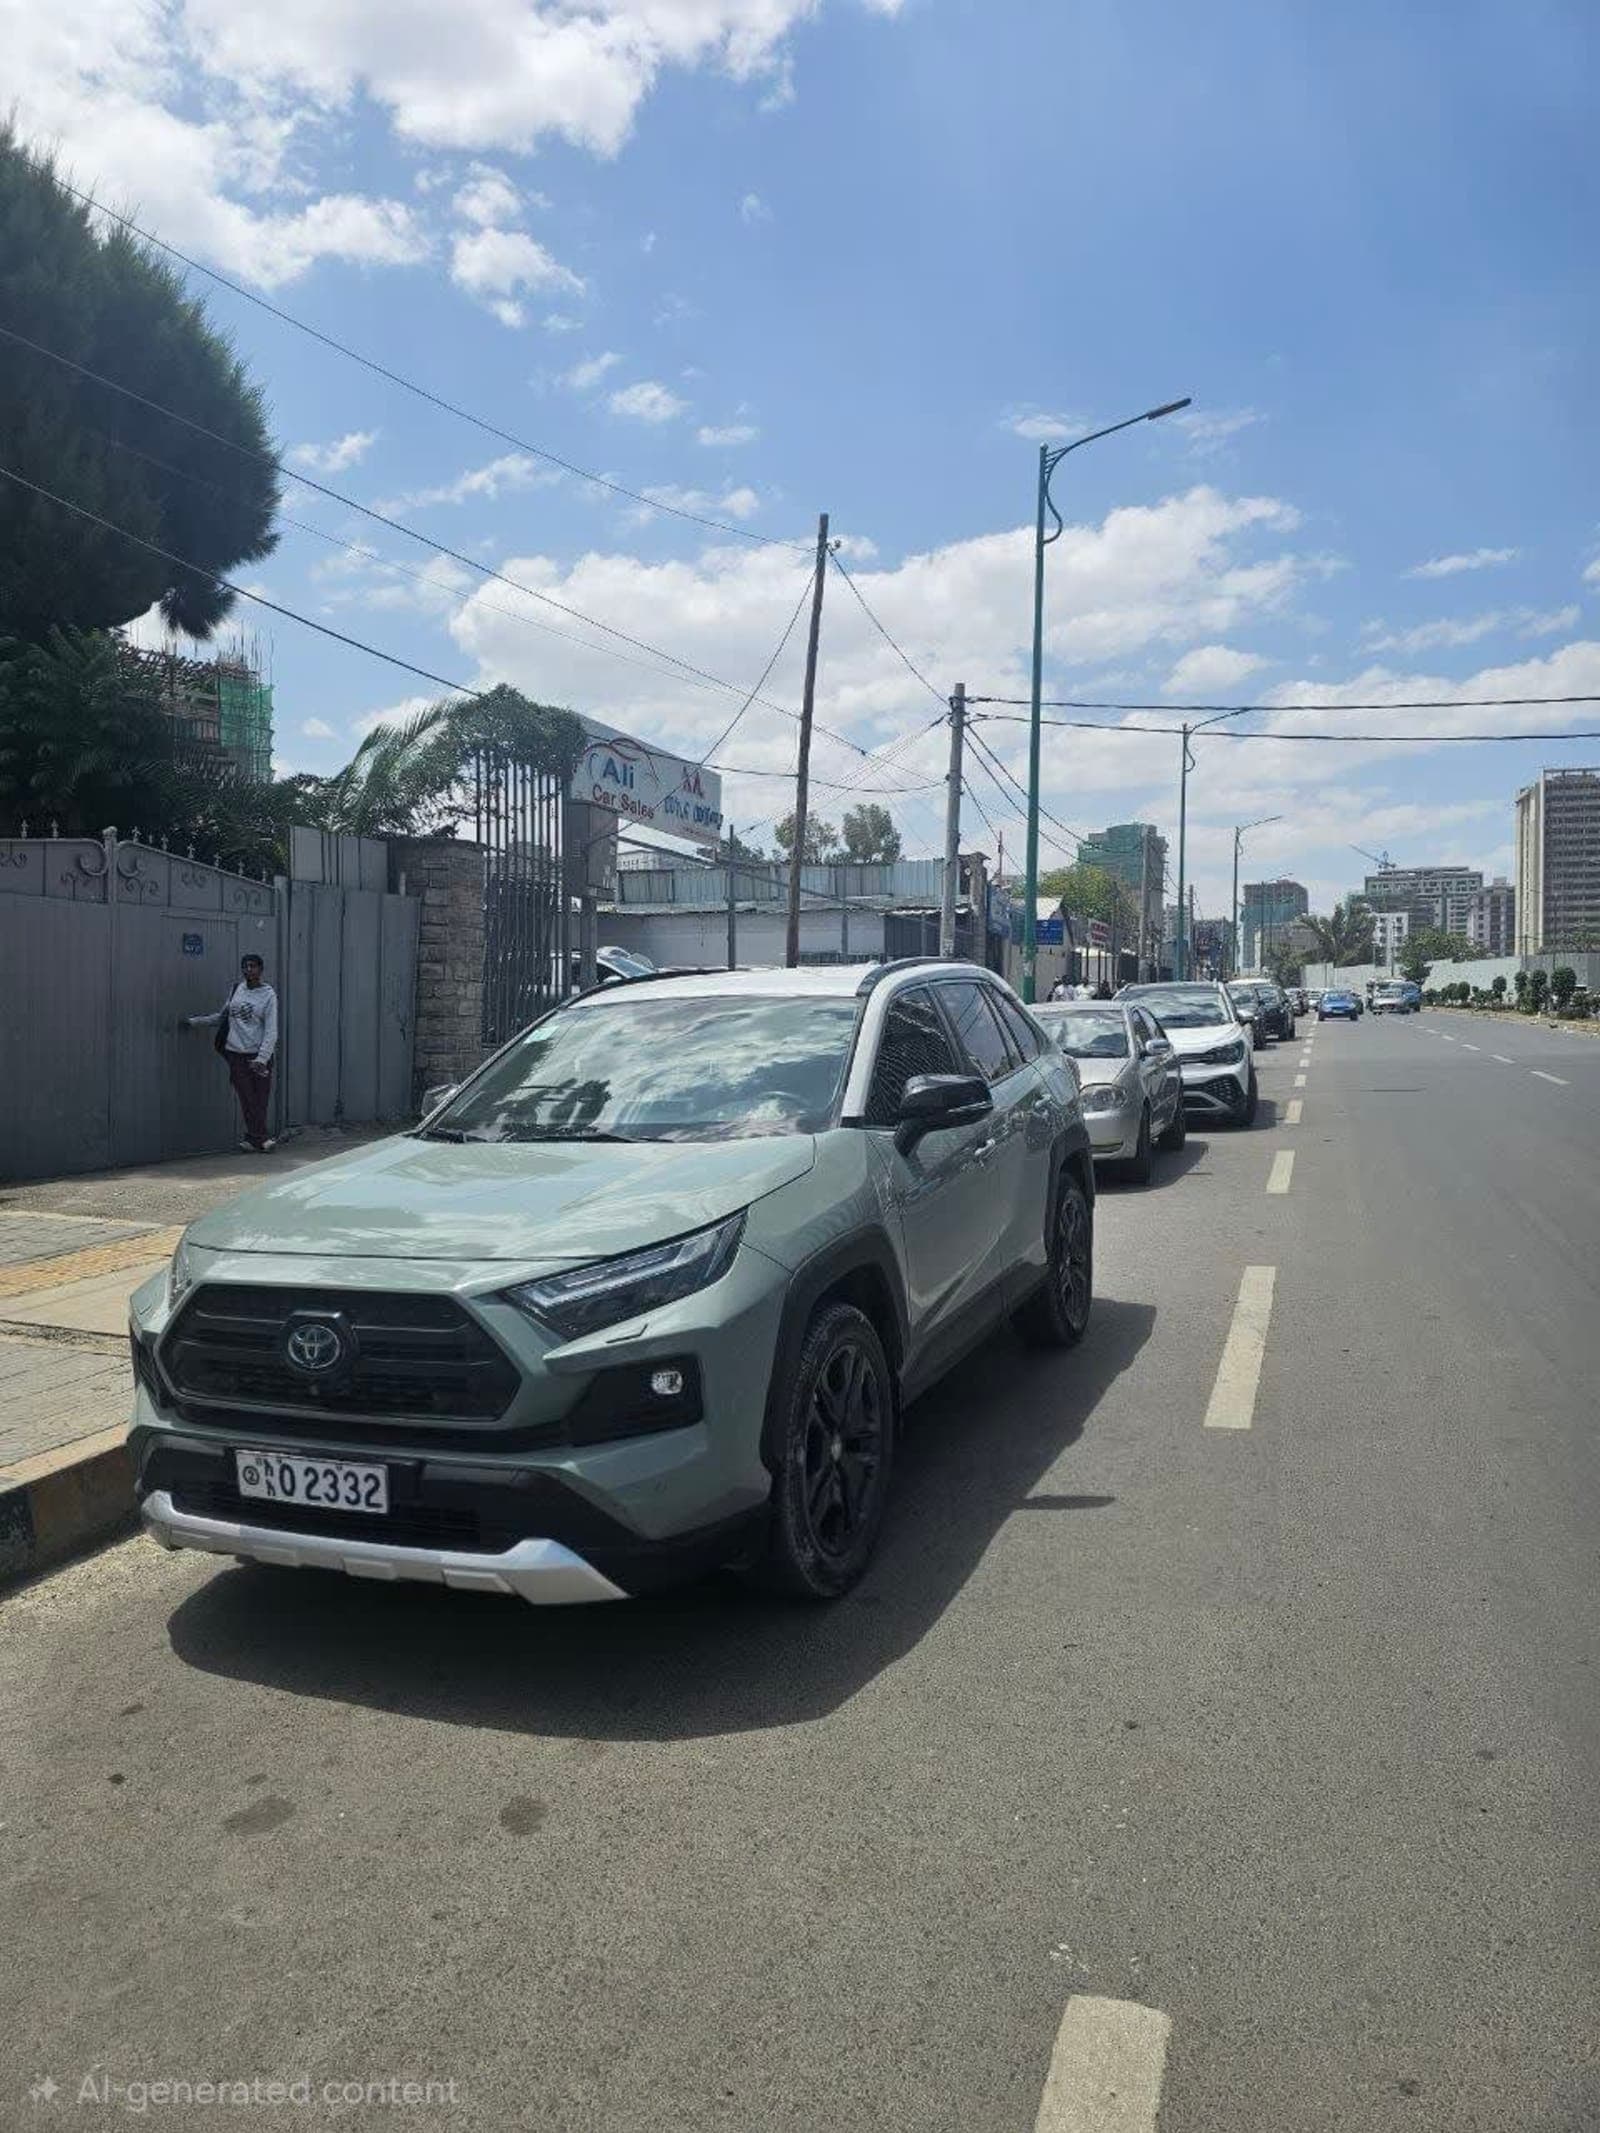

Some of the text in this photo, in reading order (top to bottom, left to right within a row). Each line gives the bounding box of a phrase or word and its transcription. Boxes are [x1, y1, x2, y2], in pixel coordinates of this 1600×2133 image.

[602, 757, 635, 789] Ali
[592, 783, 655, 820] Car Sales
